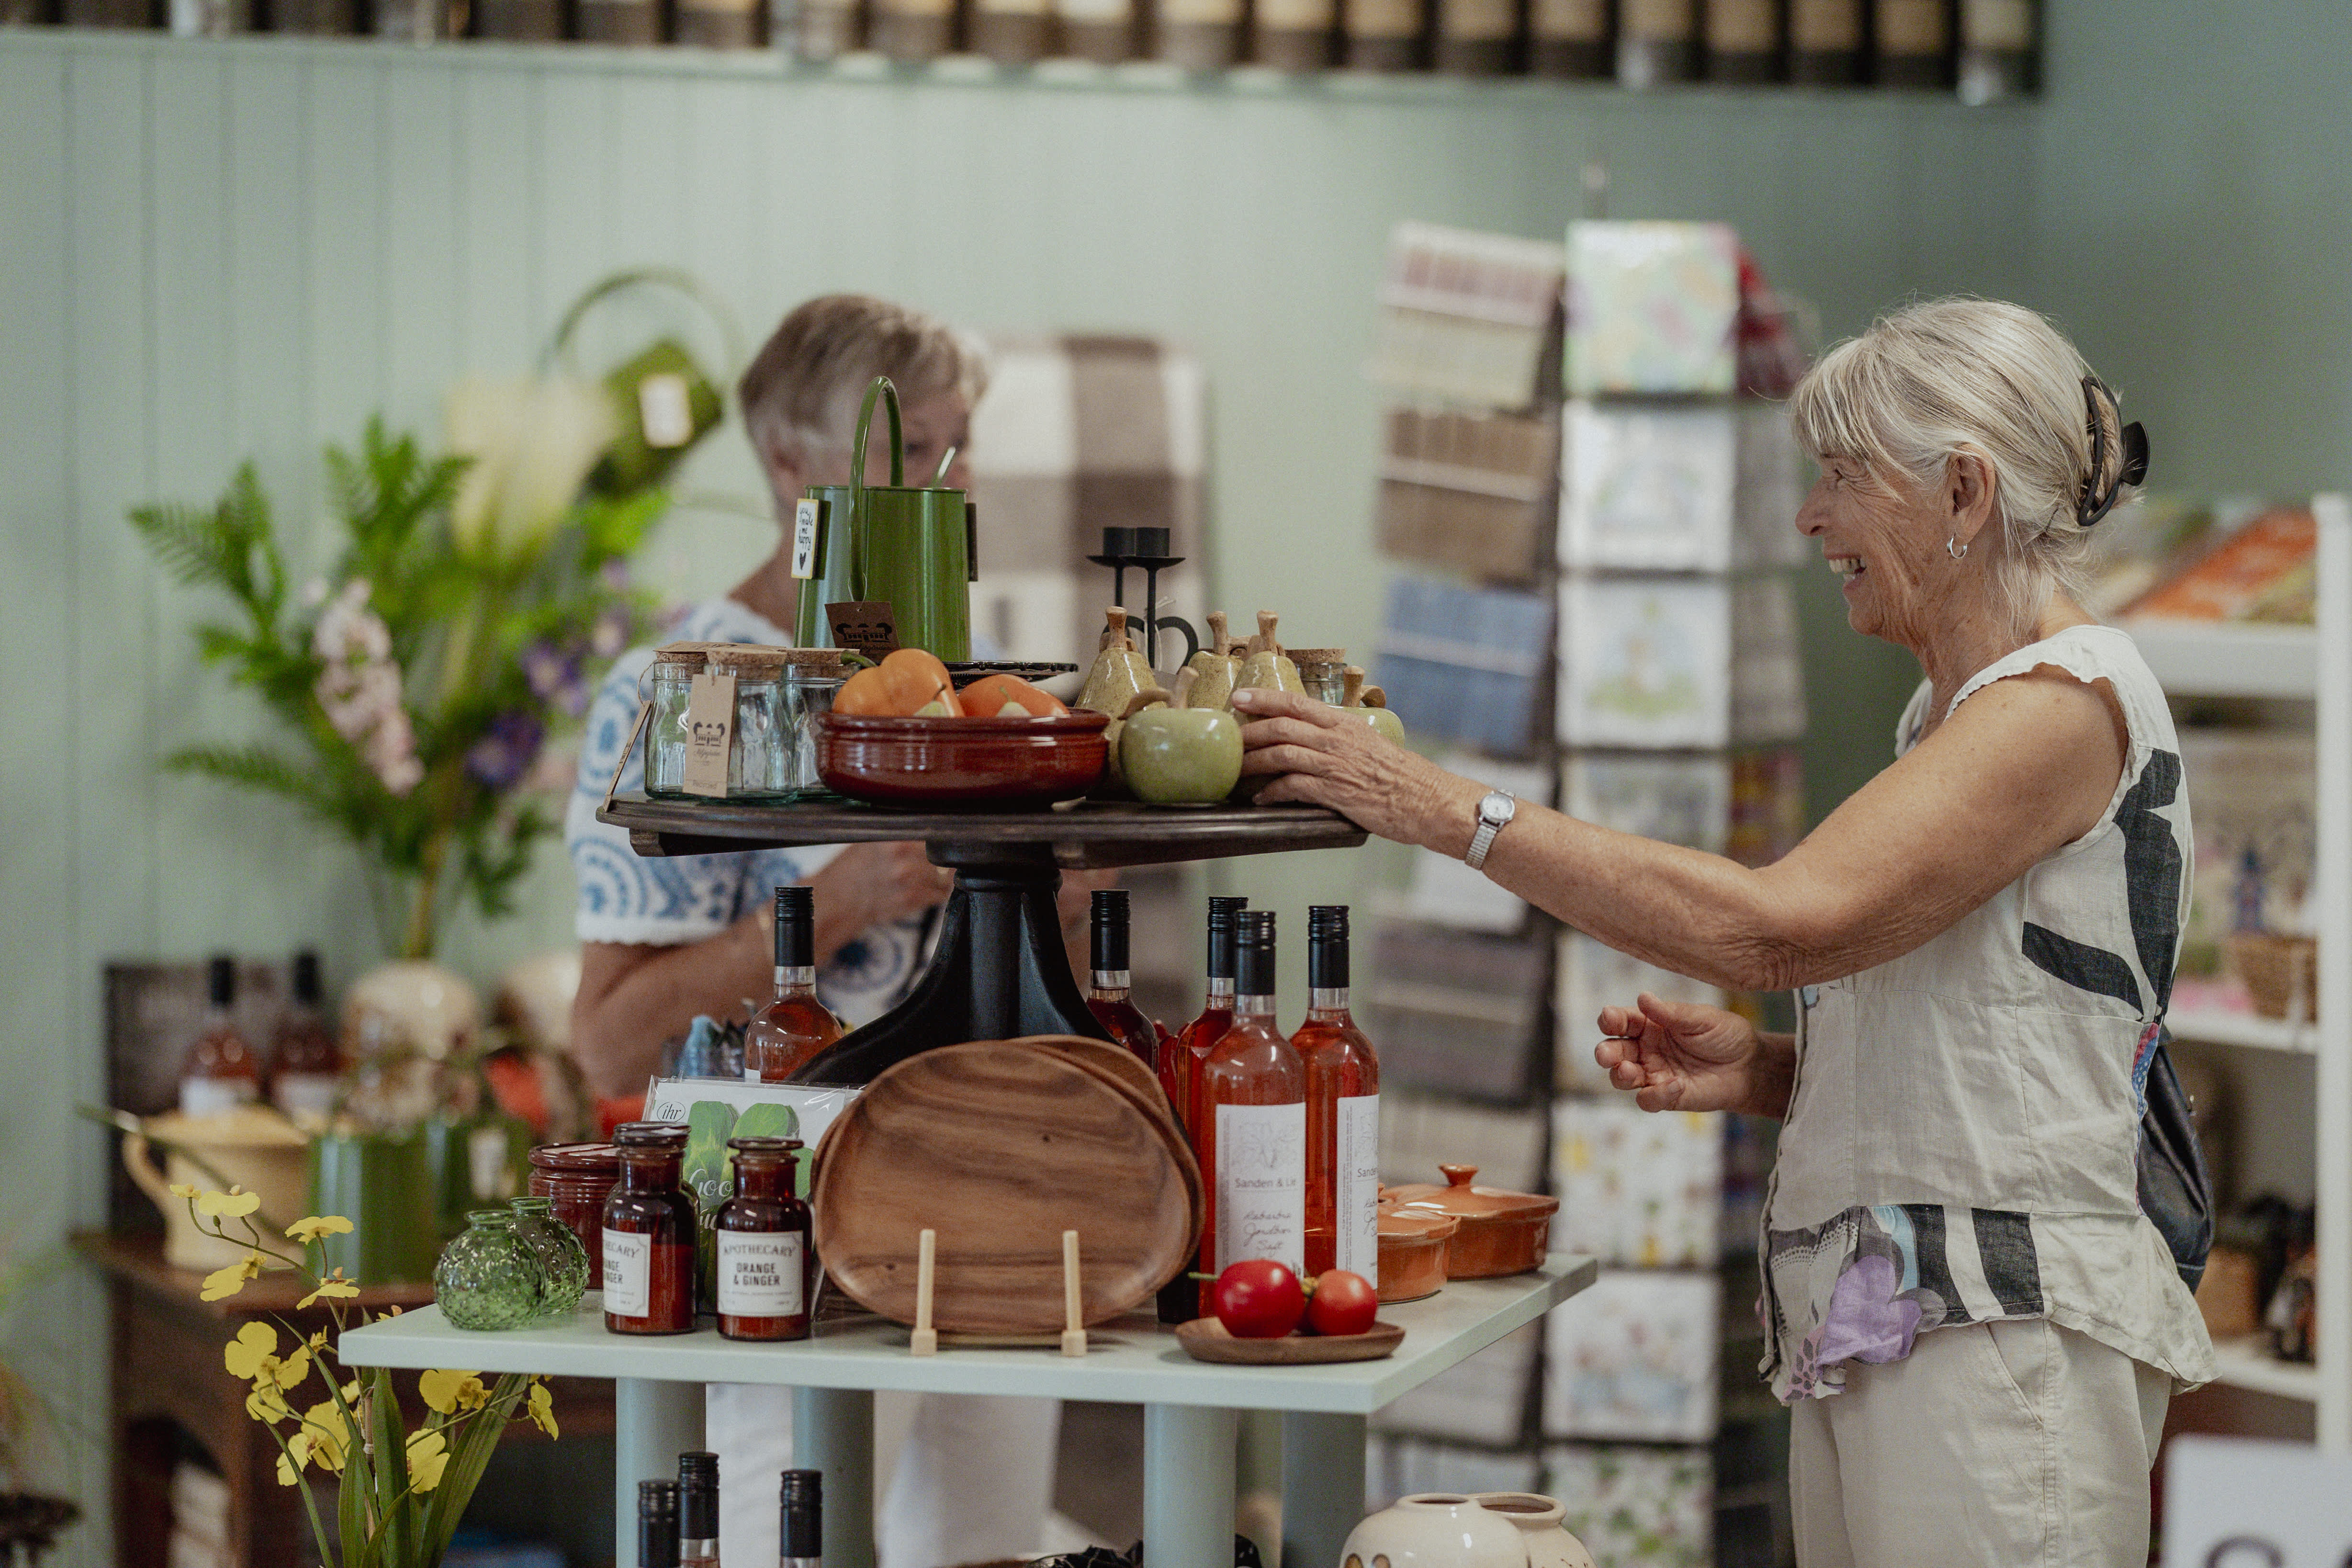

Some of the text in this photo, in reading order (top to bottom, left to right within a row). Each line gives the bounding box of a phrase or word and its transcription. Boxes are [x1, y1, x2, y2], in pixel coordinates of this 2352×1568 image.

[799, 529, 811, 551] happy
[662, 1104, 682, 1120] ihr
[688, 1168, 734, 1197] Goo
[1235, 1177, 1274, 1188] Sanden
[1277, 1178, 1283, 1187] &
[723, 1244, 797, 1257] APOTHECARY
[736, 1262, 776, 1274] ORANGE
[733, 1275, 780, 1286] & GINGER
